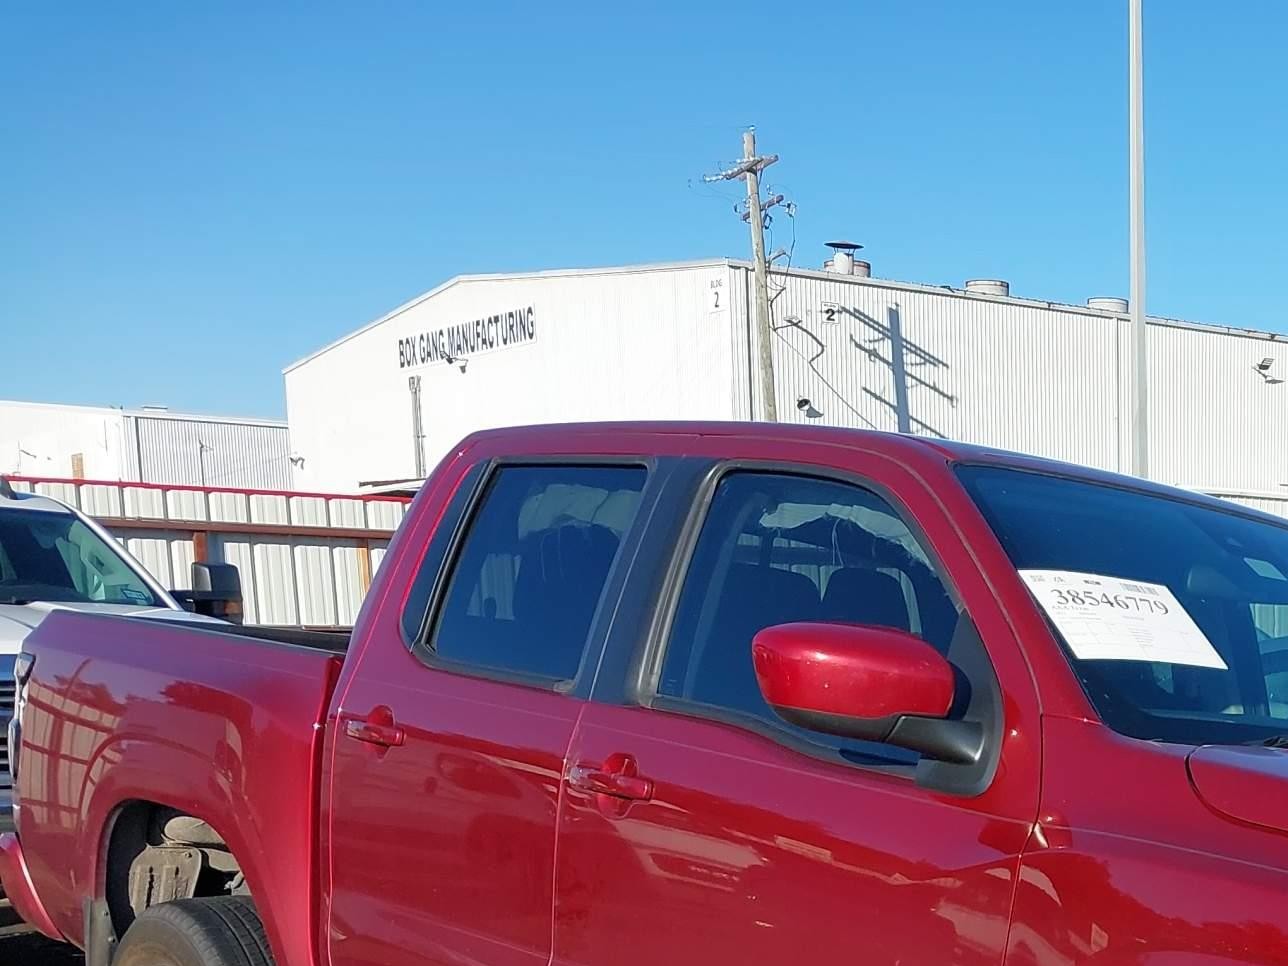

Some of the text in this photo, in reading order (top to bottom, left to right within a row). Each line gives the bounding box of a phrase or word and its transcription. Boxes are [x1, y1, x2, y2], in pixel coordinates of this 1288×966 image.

[714, 291, 719, 308] 2
[825, 308, 835, 321] 2
[399, 306, 534, 368] BOX GANG MANUFACTURING
[1050, 588, 1169, 615] 38546779
